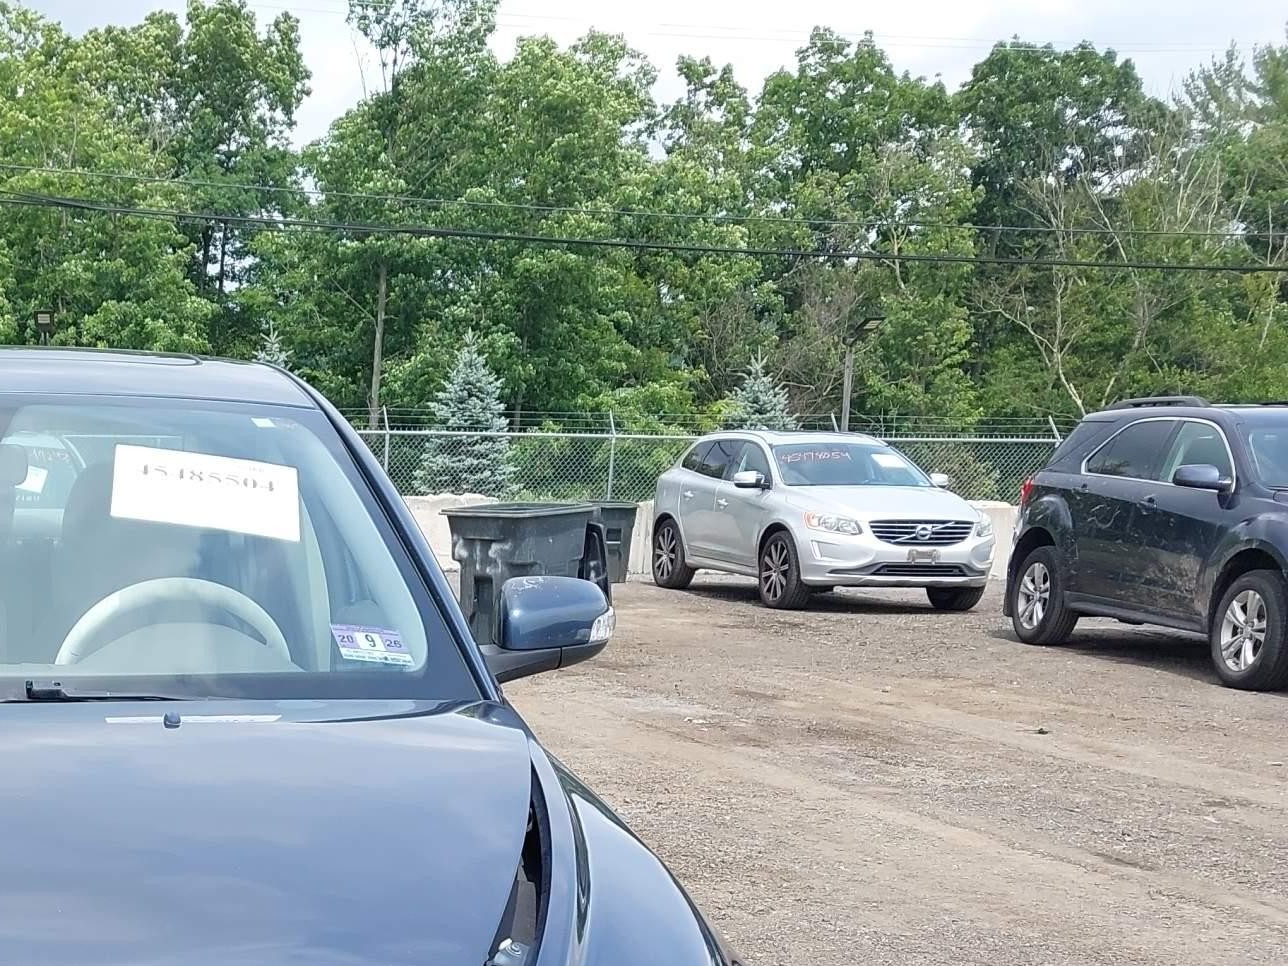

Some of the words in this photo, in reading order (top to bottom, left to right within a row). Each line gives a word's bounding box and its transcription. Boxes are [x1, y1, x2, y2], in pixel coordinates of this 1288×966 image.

[136, 463, 276, 492] 45485504
[337, 634, 354, 644] 20
[364, 633, 377, 648] 9
